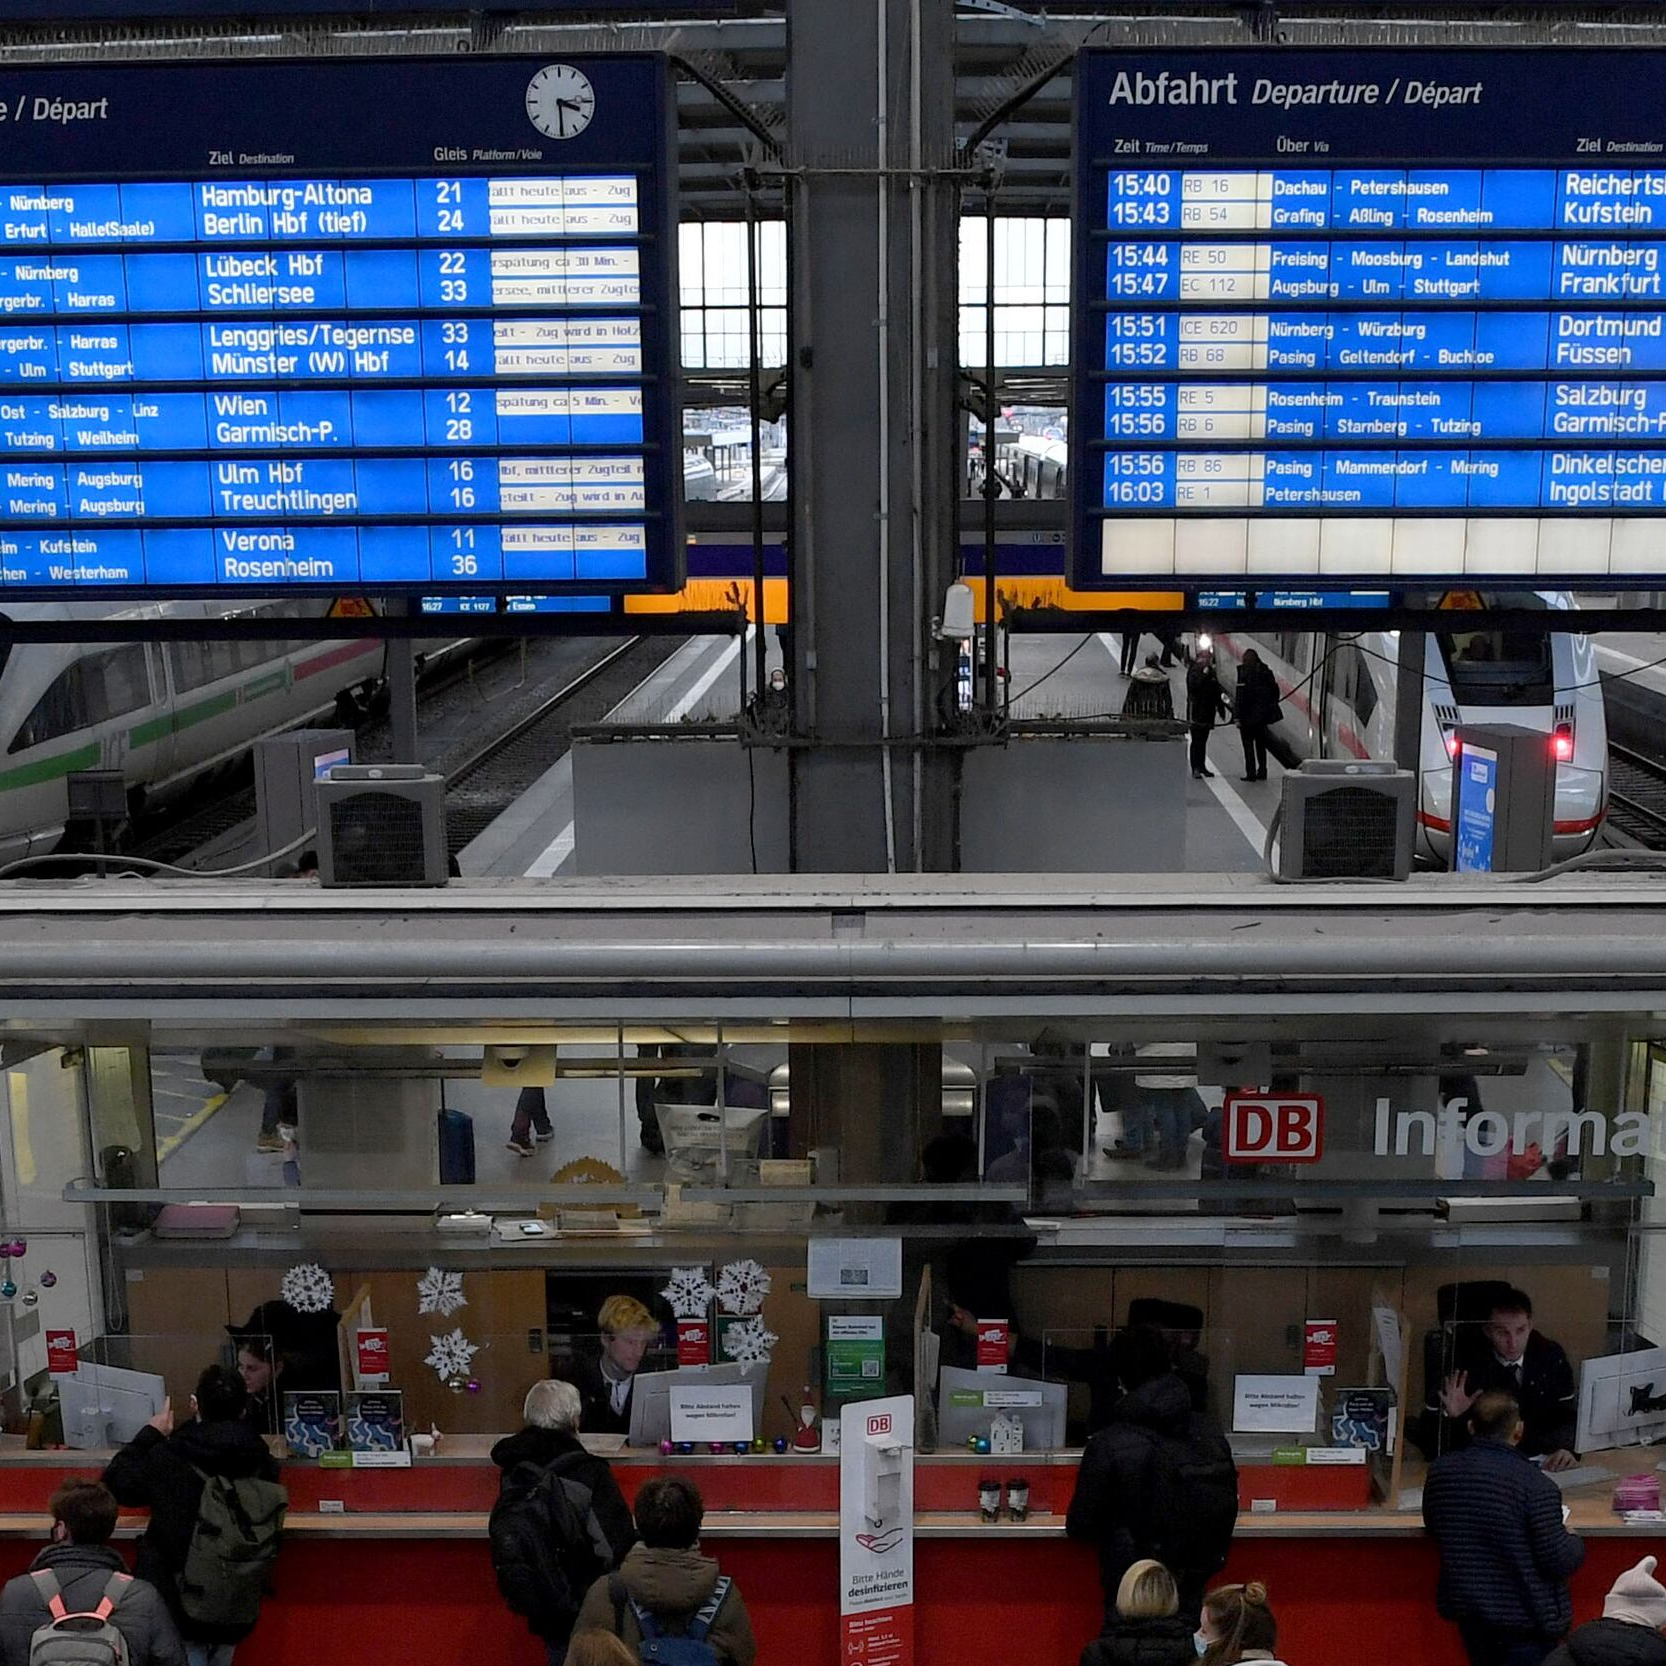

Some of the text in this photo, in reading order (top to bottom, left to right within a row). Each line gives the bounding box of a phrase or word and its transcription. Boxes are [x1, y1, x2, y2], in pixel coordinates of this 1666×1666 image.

[1109, 71, 1482, 108] Abfahrt Departure Départ
[33, 97, 108, 124] Départ
[434, 147, 542, 162] Gleis Platform/Voie
[1114, 139, 1208, 154] Zeit Time/Temps
[1277, 137, 1329, 153] Über Via
[1577, 139, 1663, 152] Ziel Destination
[209, 151, 294, 165] Ziel Destination
[437, 183, 461, 203] 21
[1113, 175, 1170, 195] 15:40
[202, 185, 372, 207] Hamburg-Altona
[204, 213, 367, 234] Berlin Hbf (tief)
[437, 211, 463, 231] 24
[1113, 203, 1169, 224] 15:43
[1564, 203, 1652, 224] Kufstein
[206, 254, 323, 277] Lübeck Hbf
[439, 253, 465, 274] 22
[1113, 246, 1168, 266] 15:44
[1562, 245, 1657, 269] Nürnberg
[440, 281, 467, 301] 33
[1112, 273, 1168, 294] 15:47
[1561, 273, 1660, 294] Frankfurt
[208, 284, 315, 304] Schliersee
[442, 323, 468, 344] 33
[1111, 316, 1165, 336] 15:51
[1559, 316, 1661, 337] Dortmund
[211, 326, 414, 351] Lenggries/Tegernse
[213, 351, 389, 373] Münster (W) Hbf
[445, 351, 469, 371] 14
[1111, 344, 1166, 364] 15:52
[1557, 344, 1631, 364] Füssen
[215, 395, 267, 415] Wien
[446, 393, 471, 413] 12
[1111, 386, 1165, 406] 15:55
[1556, 386, 1646, 410] Salzburg
[216, 422, 338, 444] Garmisch-P.
[446, 420, 472, 440] 28
[1110, 413, 1165, 433] 15:56
[218, 463, 303, 484] Ulm Hbf
[449, 461, 473, 481] 16
[1109, 455, 1164, 475] 15:56
[221, 490, 357, 513] Treuchtlingen
[450, 488, 475, 508] 16
[1109, 481, 1163, 502] 16:03
[1550, 481, 1652, 505] Ingolstadt
[223, 531, 294, 551] Verona
[452, 530, 475, 549] 11
[225, 558, 333, 577] Rosenheim
[452, 555, 477, 575] 36
[853, 1569, 904, 1584] Bitte Hände
[848, 1581, 908, 1598] desinfizieren
